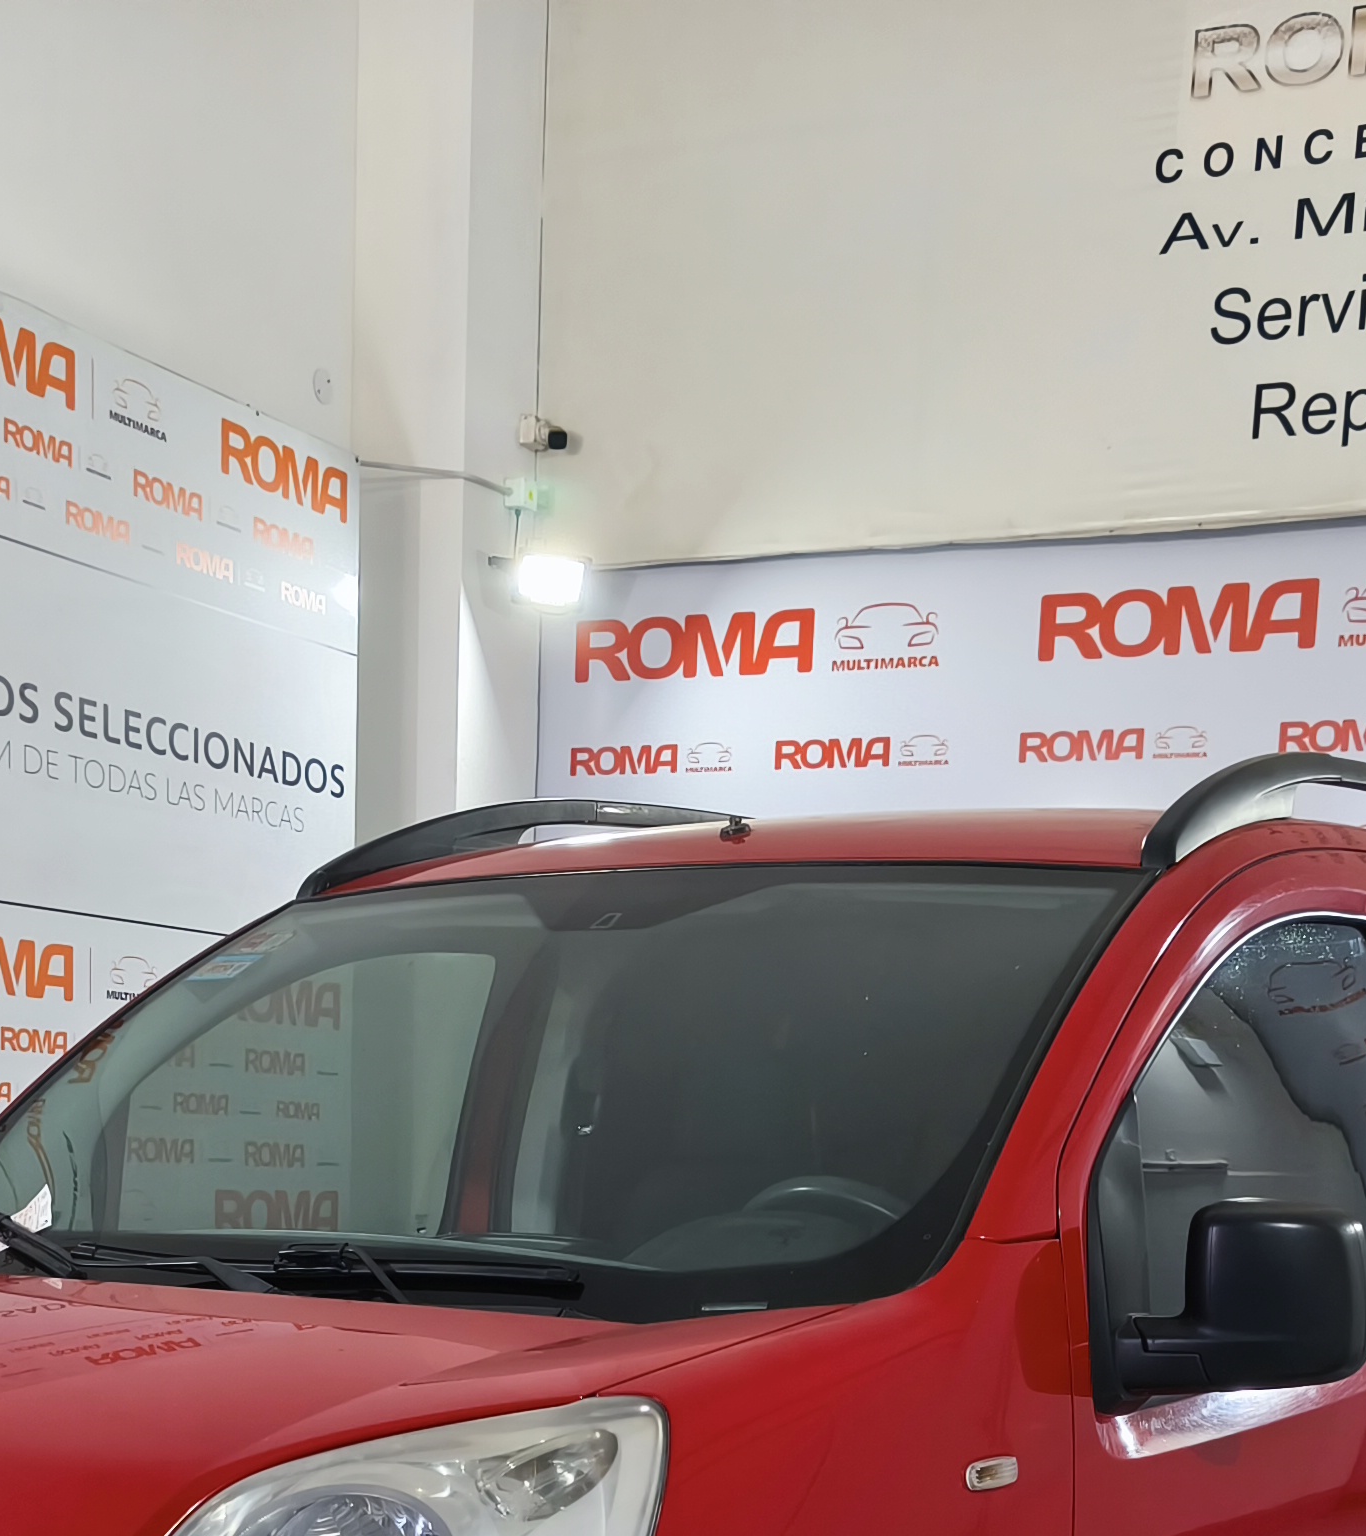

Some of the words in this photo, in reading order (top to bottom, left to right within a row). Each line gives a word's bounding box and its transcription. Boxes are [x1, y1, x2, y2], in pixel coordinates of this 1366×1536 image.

[1159, 211, 1260, 255] Av.
[4, 419, 73, 468] ROMA
[109, 409, 167, 443] MULTIMARCA
[221, 418, 347, 524] ROMA
[133, 468, 203, 522] ROMA
[65, 500, 130, 545] ROMA
[253, 515, 315, 564] ROMA
[176, 541, 234, 584] ROMA
[280, 581, 327, 615] ROMA
[1038, 578, 1320, 662] ROMA
[574, 608, 815, 683] ROMA
[831, 655, 940, 672] MULTIMARCA
[54, 690, 346, 800] SELECCIONADOS
[570, 744, 678, 777] ROMA
[774, 737, 891, 770] ROMA
[1019, 728, 1145, 763] ROMA
[22, 743, 60, 782] DE
[67, 753, 159, 802] TODAS
[166, 776, 206, 812] LAS
[213, 787, 305, 834] MARCAS
[106, 989, 143, 1001] MULTI
[235, 980, 342, 1031] OMA
[1, 1027, 68, 1057] ROMA
[244, 1048, 306, 1076] ROMA
[173, 1092, 230, 1118] ROMA
[275, 1101, 320, 1121] ROMA
[244, 1141, 306, 1168] ROMA
[213, 1189, 340, 1232] ROMA
